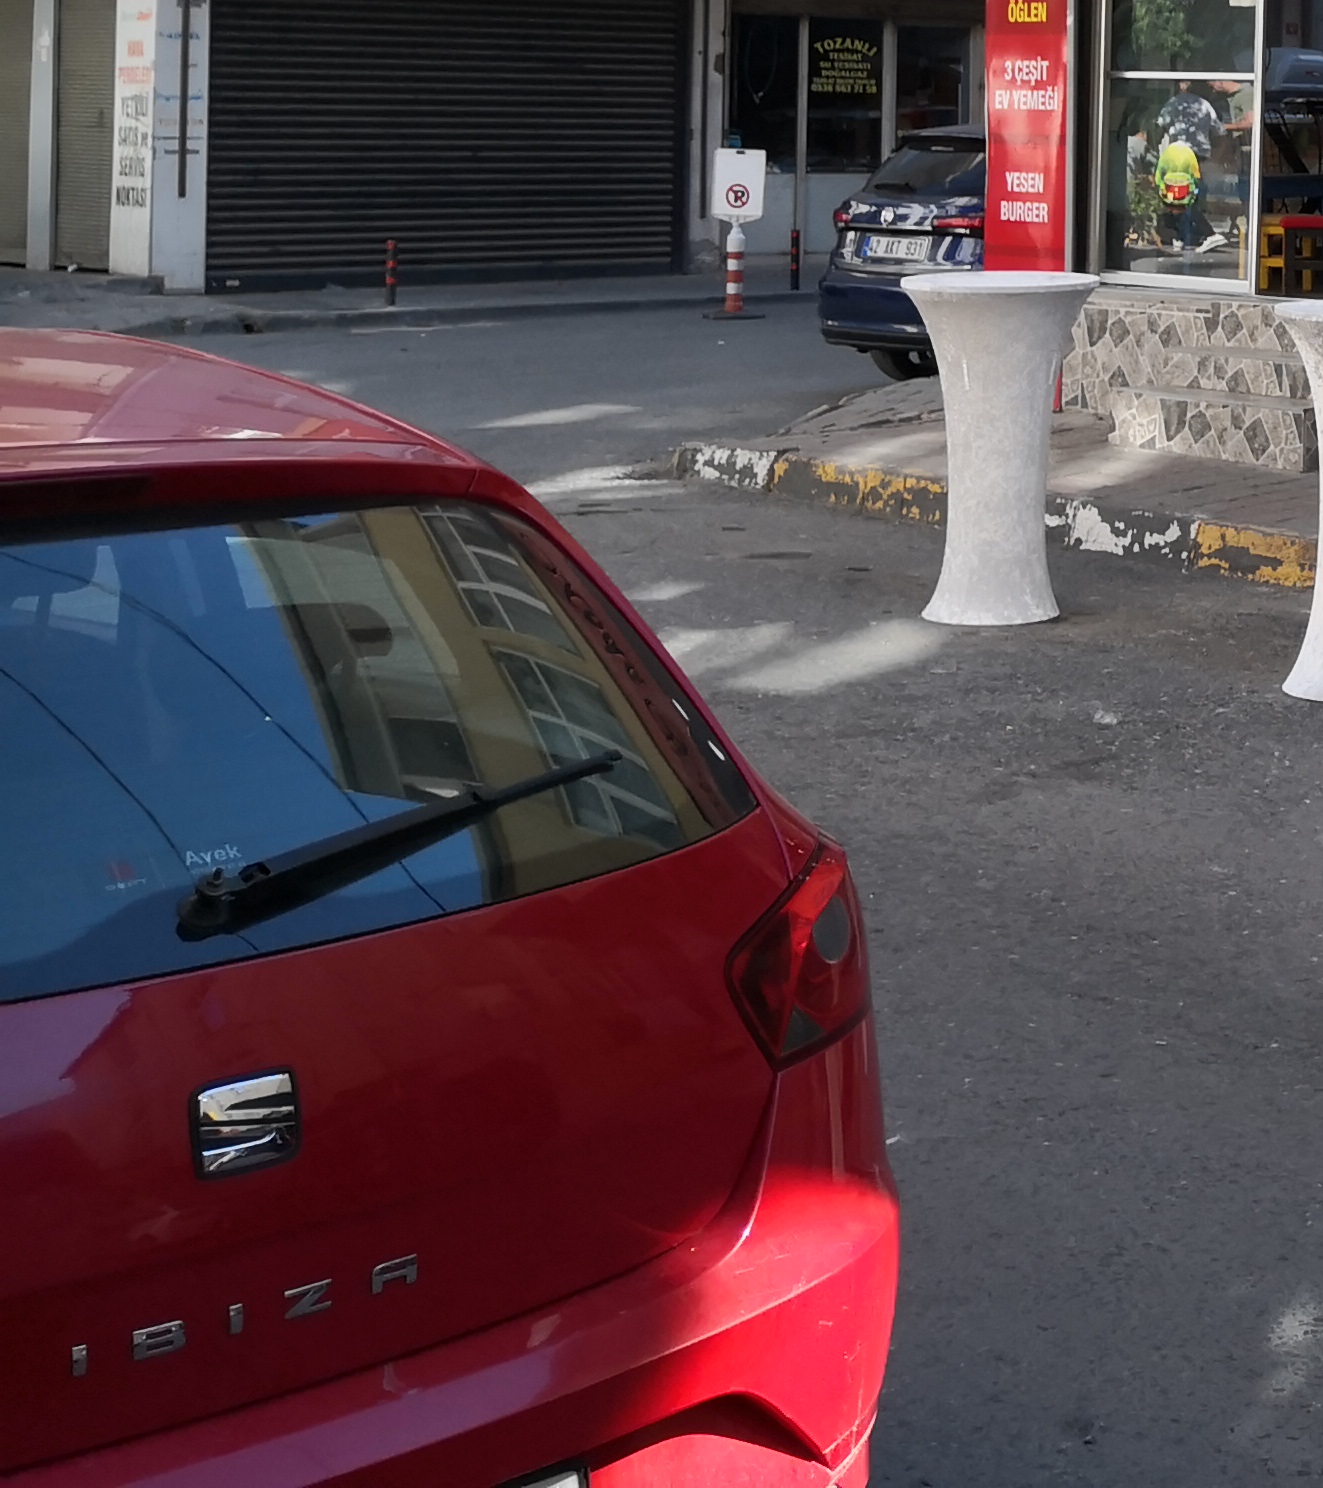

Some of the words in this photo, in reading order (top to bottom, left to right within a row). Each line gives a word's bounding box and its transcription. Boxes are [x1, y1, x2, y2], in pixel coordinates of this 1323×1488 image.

[1004, 60, 1013, 81] 3
[1015, 56, 1049, 86] ÇEŞİT
[995, 89, 1009, 109] EV
[1012, 86, 1058, 111] YEMEĞİ
[1005, 171, 1044, 193] YESEN
[1000, 200, 1049, 223] BURGER
[71, 1254, 418, 1377] IBIZA
